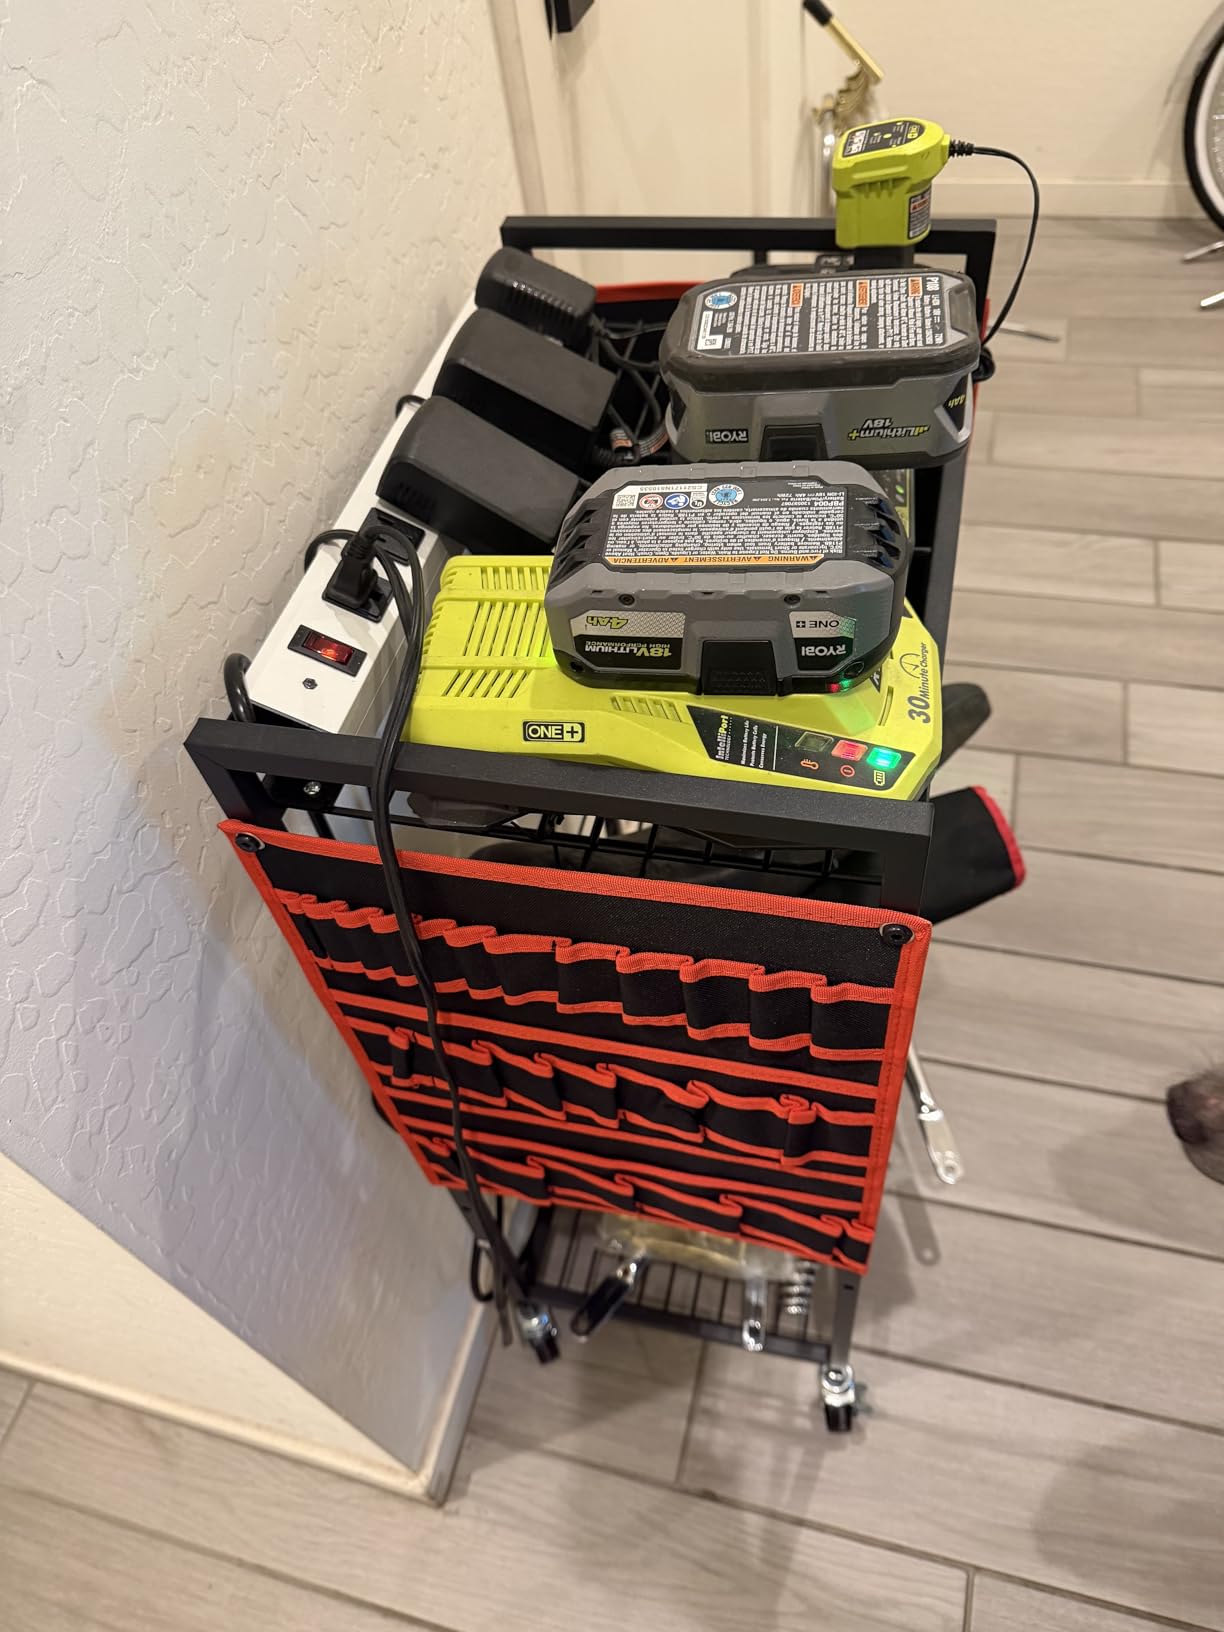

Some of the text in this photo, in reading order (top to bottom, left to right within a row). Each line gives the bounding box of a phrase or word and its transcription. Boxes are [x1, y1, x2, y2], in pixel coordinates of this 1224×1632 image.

[862, 418, 893, 428] 18V
[709, 431, 747, 442] RYOBI
[586, 616, 629, 630] 4Ah
[801, 644, 846, 656] RYOBI
[907, 642, 930, 723] 30 Minute Charger
[716, 715, 728, 760] IntelliPort
